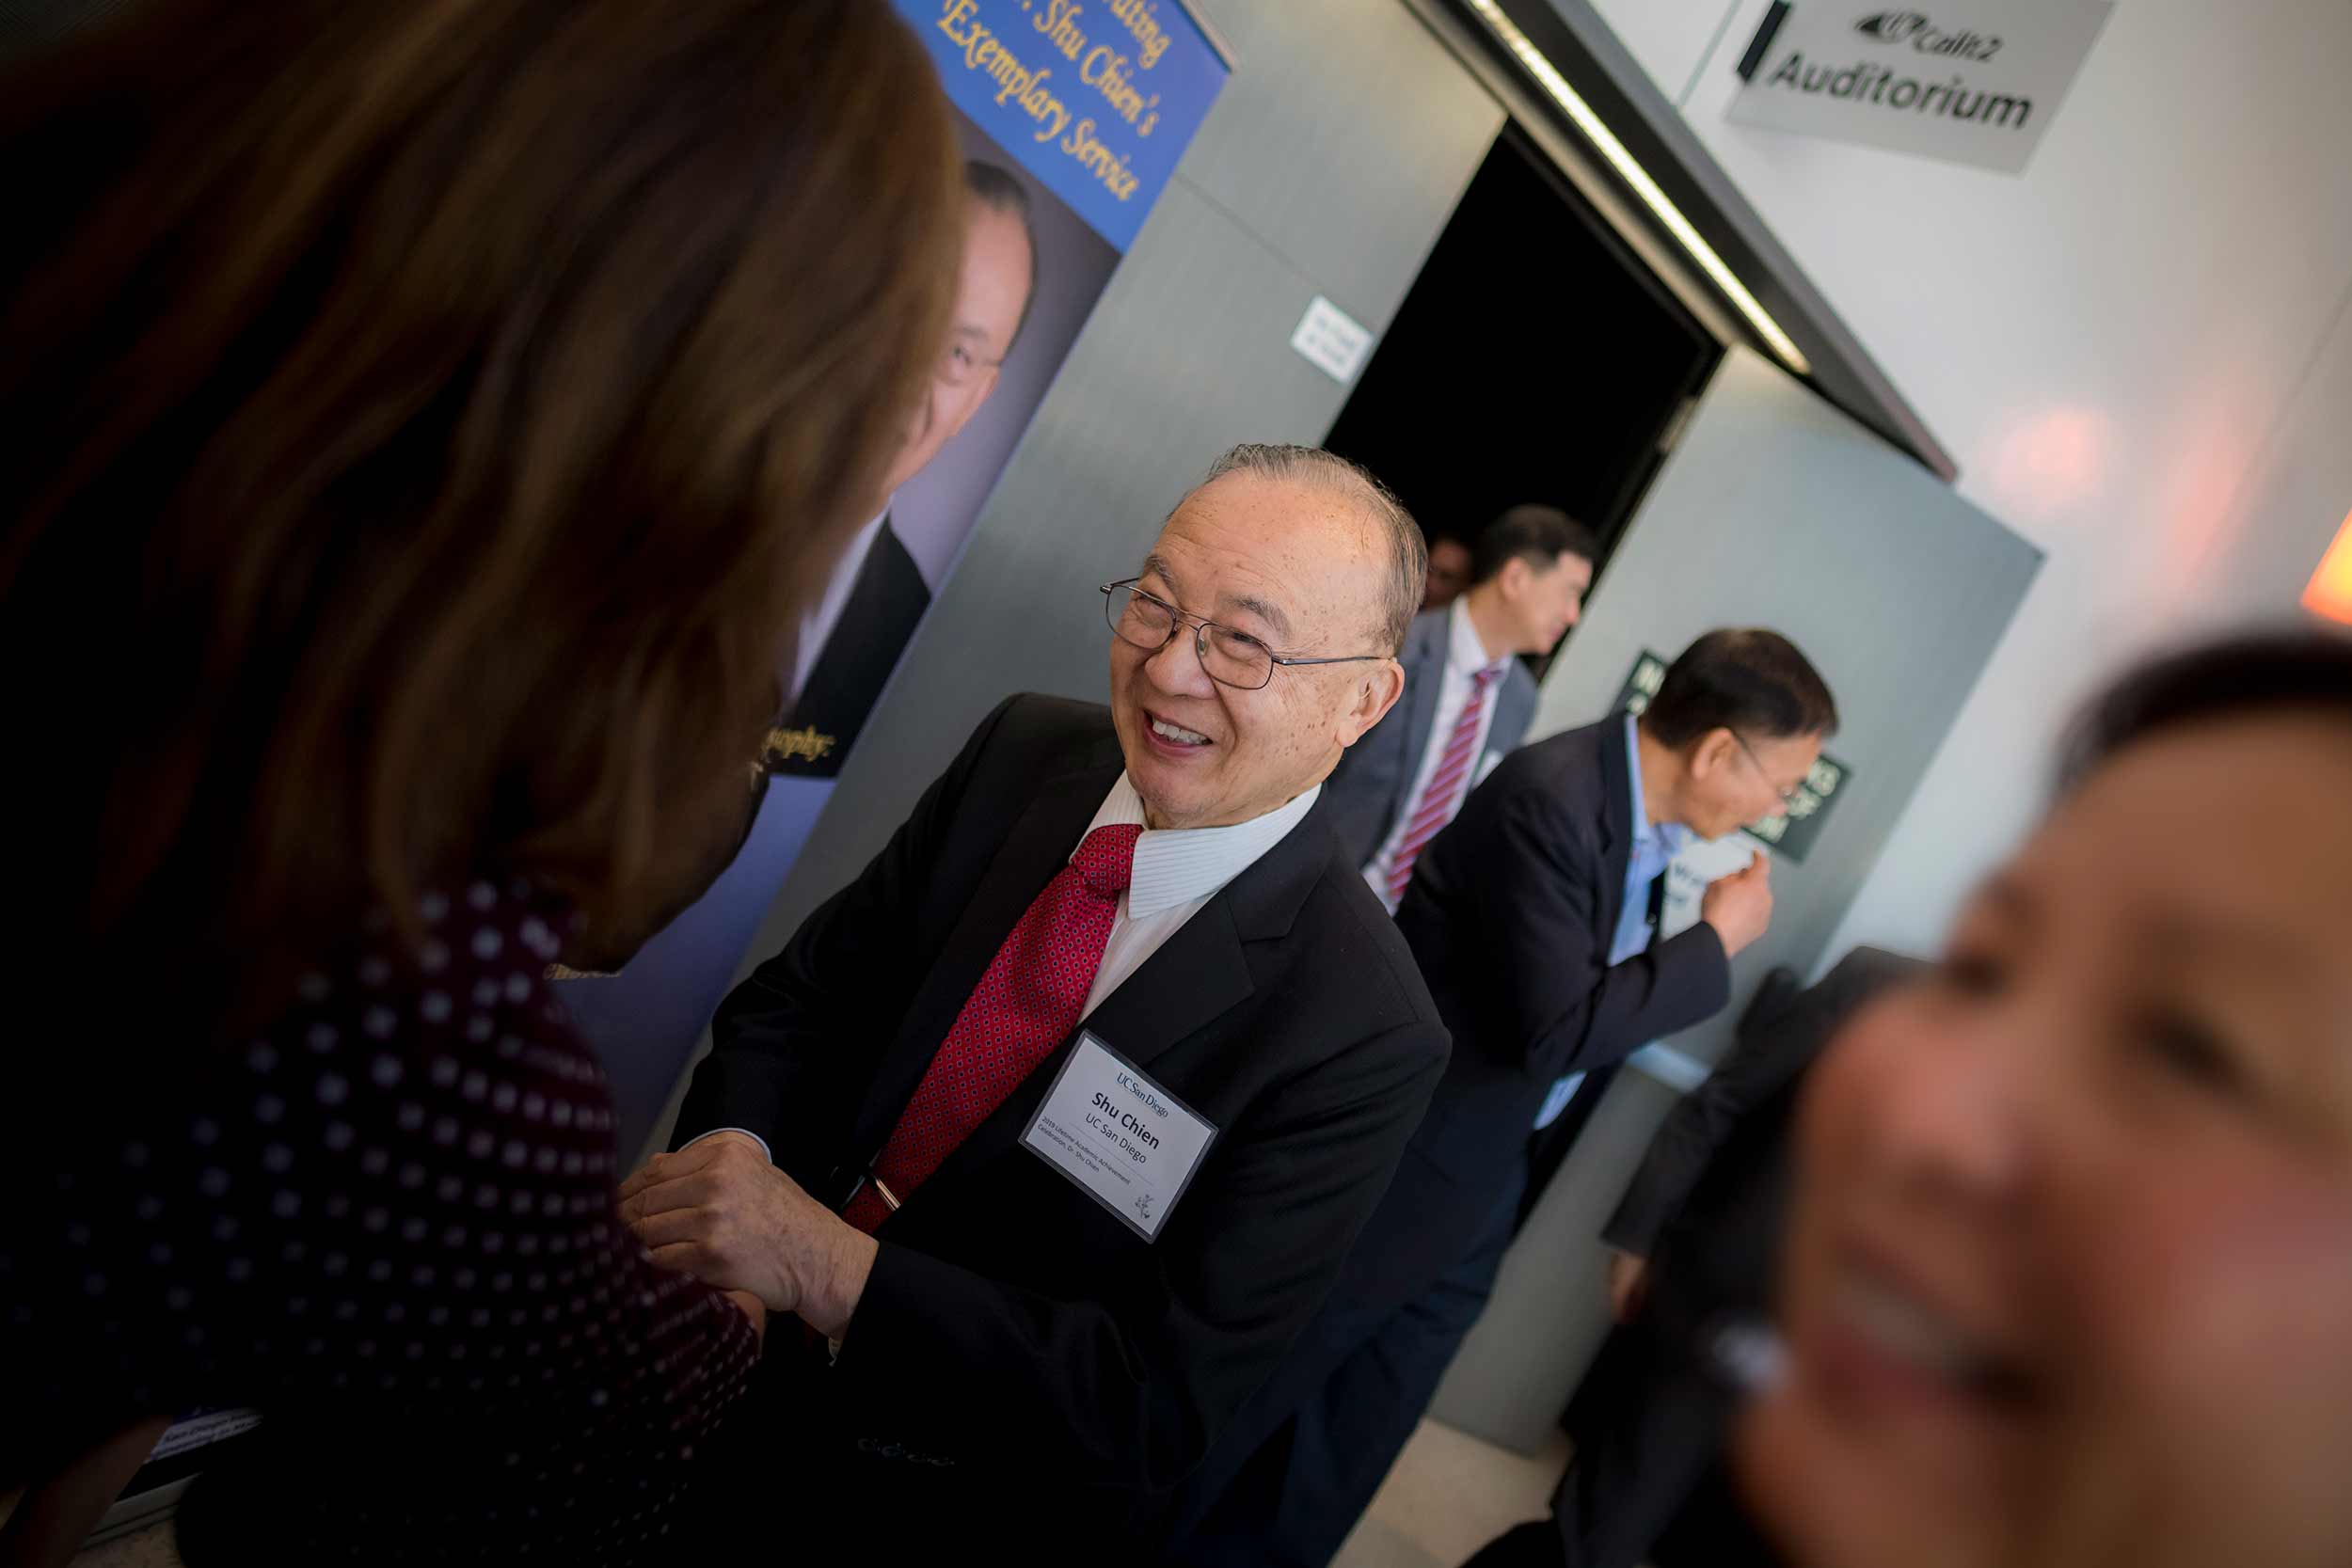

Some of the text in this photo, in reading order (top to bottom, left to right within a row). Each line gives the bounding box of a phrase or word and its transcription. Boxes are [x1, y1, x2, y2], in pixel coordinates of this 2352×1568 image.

[1102, 0, 1170, 70] uting
[936, 0, 1139, 201] Exemplary Service
[1080, 45, 1161, 137] Chien's
[1771, 51, 2034, 130] Auditorium
[1091, 1092, 1159, 1149] Shu Chien
[1117, 1072, 1168, 1117] UC San Diego
[1055, 1125, 1074, 1143] Lifetime
[1074, 1140, 1099, 1161] Academic
[1098, 1158, 1131, 1184] Achievement
[1075, 1150, 1086, 1163] Shu
[1085, 1158, 1099, 1172] Chien
[1086, 1113, 1147, 1164] UC San Diego
